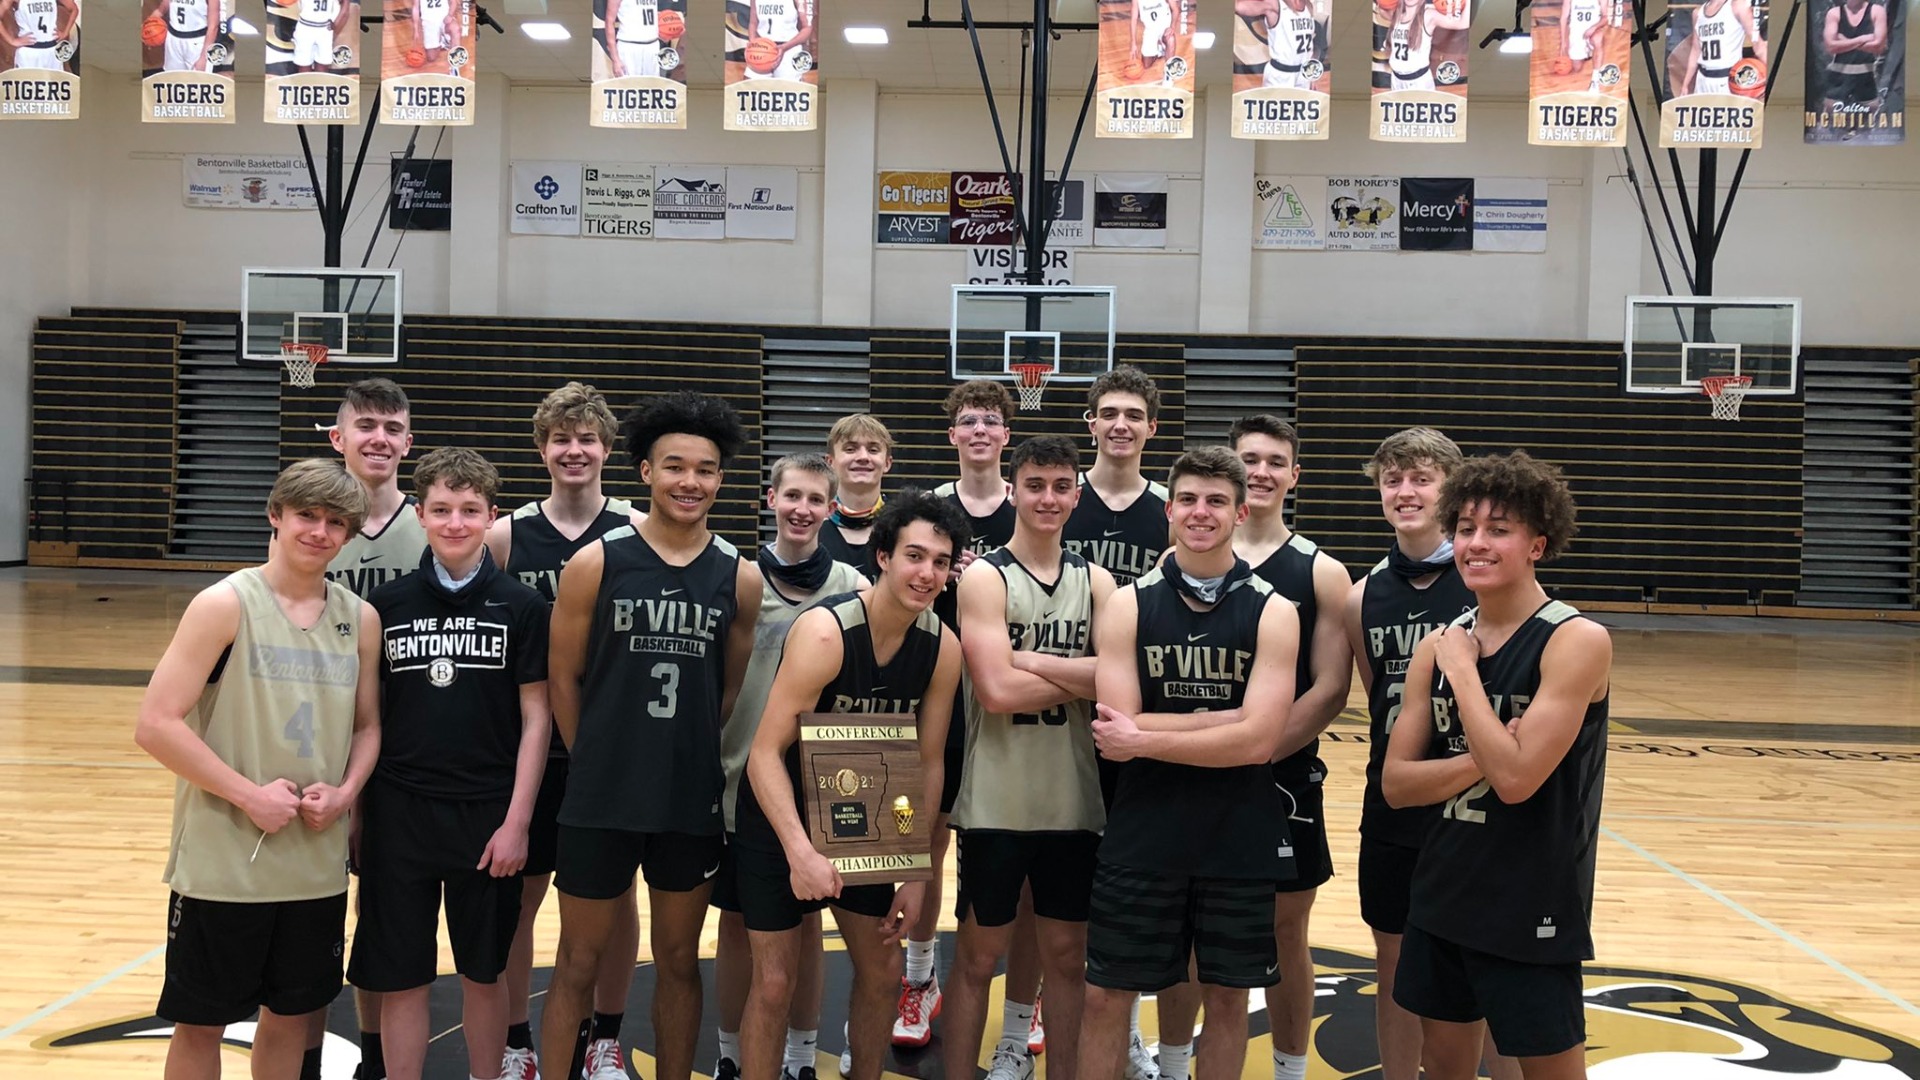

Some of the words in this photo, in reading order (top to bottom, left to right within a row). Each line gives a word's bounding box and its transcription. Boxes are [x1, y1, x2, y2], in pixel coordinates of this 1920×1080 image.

[177, 7, 185, 24] 5
[642, 9, 655, 25] 10
[758, 4, 784, 15] TIGERS
[1150, 11, 1158, 21] 0
[1577, 12, 1592, 21] 30
[37, 16, 47, 33] 4
[767, 18, 773, 34] 1
[1296, 34, 1312, 54] 22
[2, 81, 71, 101] TIGERS
[153, 84, 225, 104] TIGERS
[278, 85, 350, 106] TIGERS
[393, 86, 465, 107] TIGERS
[603, 88, 677, 110] TIGERS
[3, 103, 71, 114] BASKETBALL
[737, 91, 810, 112] TIGERS
[1109, 98, 1184, 119] TIGERS
[1832, 101, 1870, 113] Dalton
[153, 105, 225, 118] BASKETBALL
[277, 107, 350, 119] BASKETBALL
[392, 107, 465, 120] BASKETBALL
[602, 110, 677, 124] BASKETBALL
[1243, 100, 1320, 120] TIGERS
[1380, 102, 1457, 124] TIGERS
[1539, 105, 1618, 127] TIGERS
[1675, 107, 1754, 128] TIGERS
[736, 113, 809, 126] BASKETBALL
[1107, 120, 1184, 134] BASKETBALL
[1242, 121, 1319, 135] BASKETBALL
[1379, 123, 1456, 138] BASKETBALL
[1538, 127, 1616, 142] BASKETBALL
[1673, 129, 1752, 143] BASKETBALL
[197, 158, 246, 168] Bentonville
[248, 158, 291, 168] Basketball
[293, 159, 309, 169] Clu
[587, 170, 597, 180] R
[1328, 179, 1350, 187] BOB
[1354, 178, 1399, 188] MOREY'S
[190, 184, 221, 193] Walmart
[585, 187, 605, 197] Travis
[607, 188, 613, 197] L.
[615, 187, 635, 200] Riggs,
[637, 189, 651, 198] CPA
[1256, 180, 1271, 192] Go
[1257, 186, 1282, 201] Tigers
[655, 193, 678, 205] HOME
[683, 194, 725, 207] CONCERNS
[881, 185, 899, 202] Go
[902, 184, 948, 206] Tigers!
[515, 203, 558, 215] Crafton
[560, 204, 578, 215] Tull
[728, 203, 742, 211] First
[1403, 201, 1456, 221] Mercy
[1507, 211, 1544, 220] Dougherty
[585, 219, 651, 235] TIGERS
[888, 216, 941, 236] ARVEST
[1328, 231, 1350, 239] AUTO
[1353, 231, 1377, 239] BODY,
[1381, 231, 1397, 239] INC.
[974, 248, 1068, 269] VISTOR
[413, 617, 438, 632] WE
[443, 617, 476, 631] ARE
[613, 599, 723, 641] B'VILLE
[1008, 619, 1087, 651] B'VILLE
[388, 634, 502, 661] BENTONVILLE
[633, 637, 703, 655] BASKETBALL
[251, 645, 353, 685] Bentonville
[1144, 644, 1252, 682] B'VILLE
[436, 664, 448, 680] B
[647, 663, 680, 718] 3
[284, 702, 315, 758] 4
[816, 726, 904, 740] CONFERENCE
[819, 776, 834, 789] 20
[832, 854, 914, 871] CHAMPIONS
